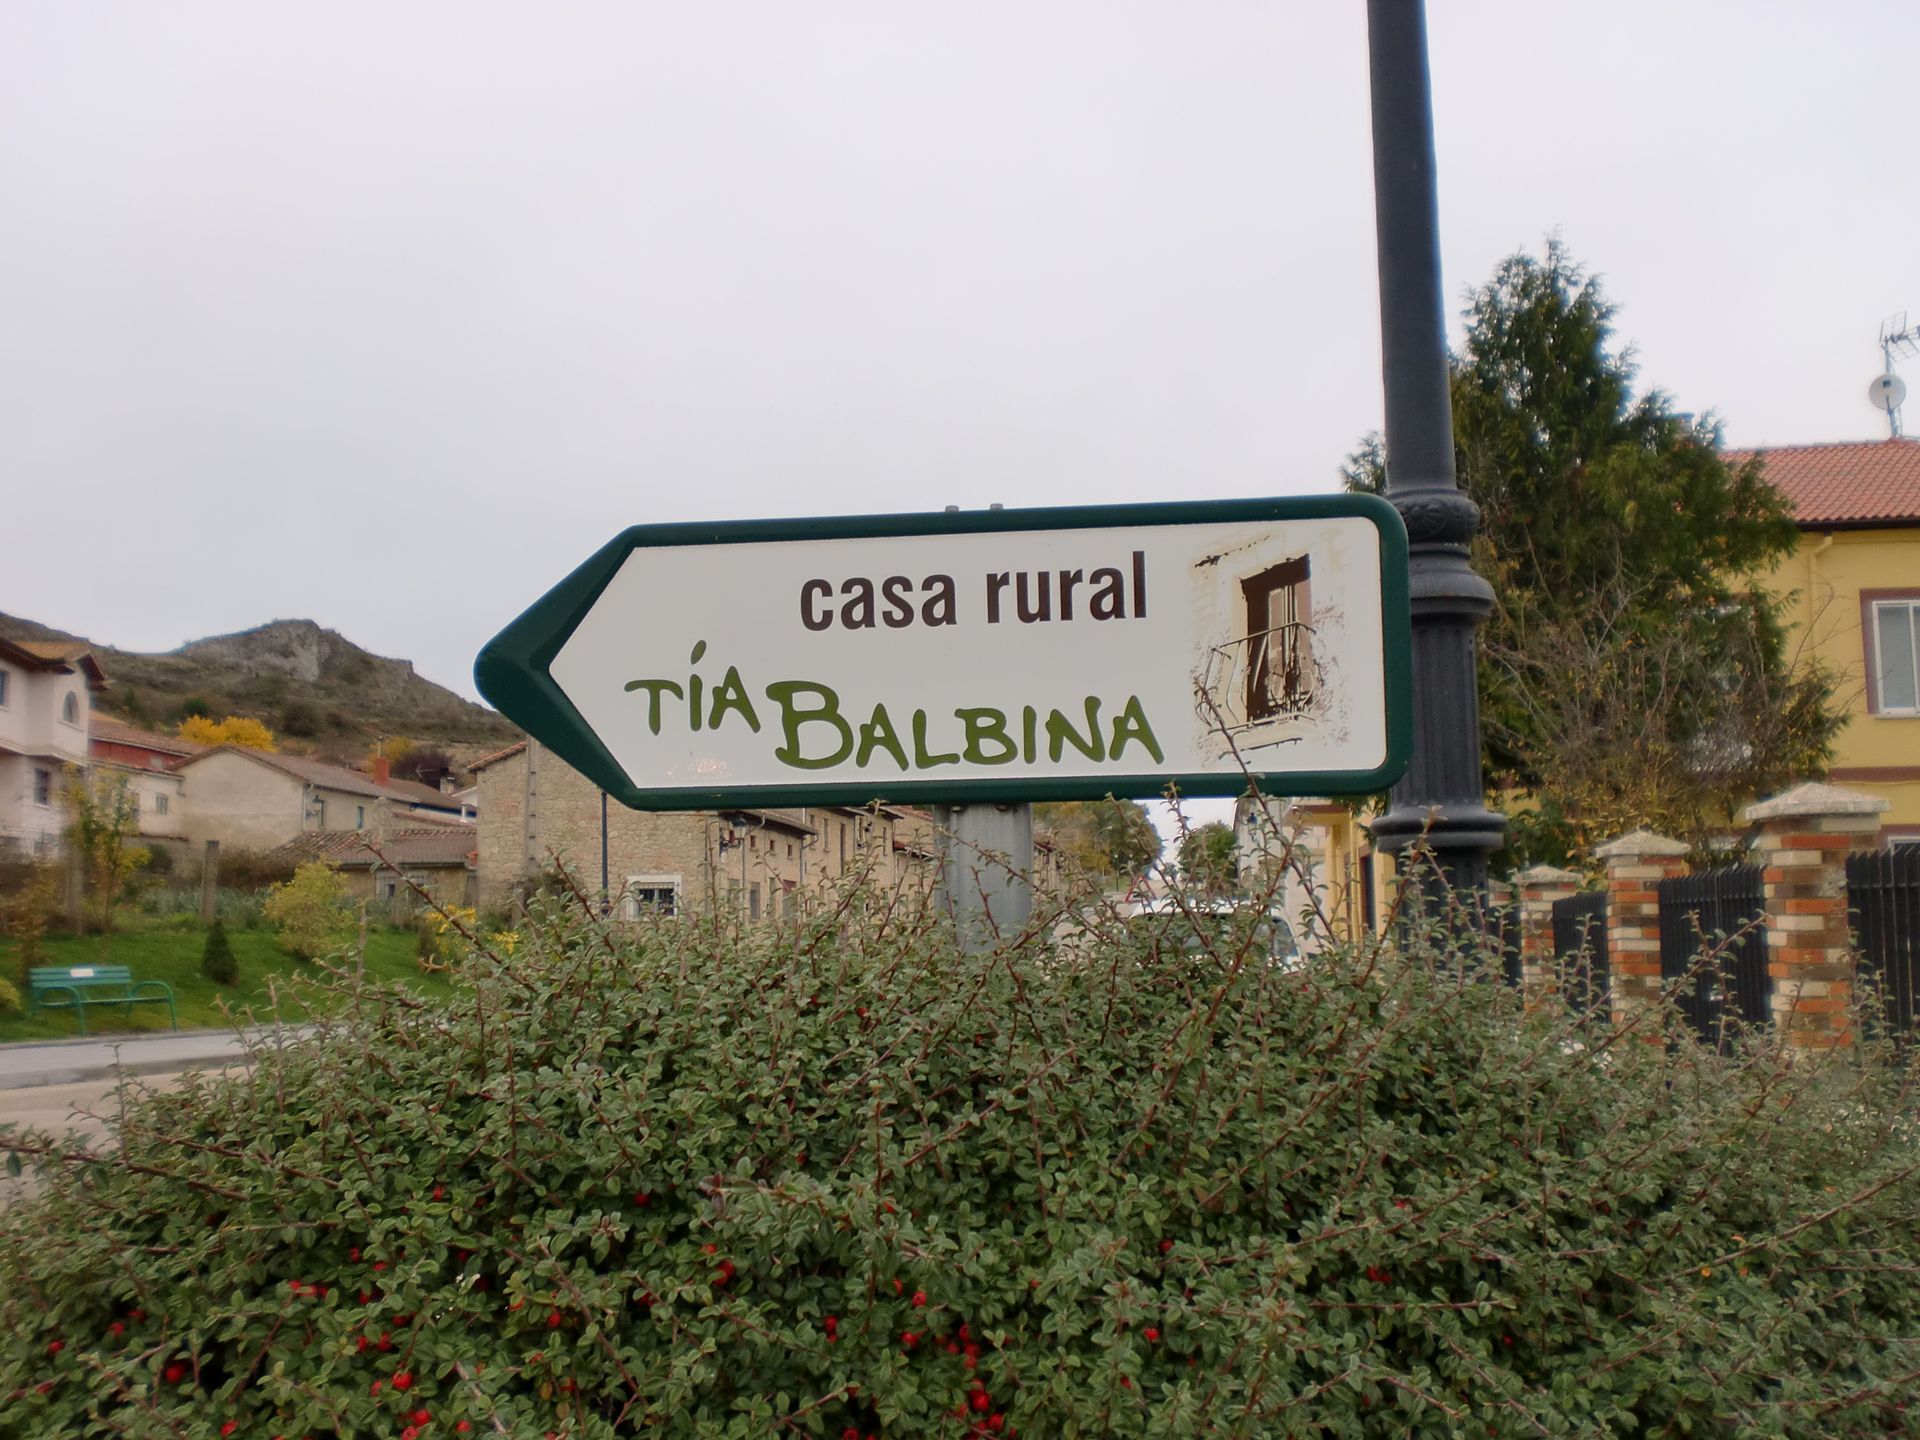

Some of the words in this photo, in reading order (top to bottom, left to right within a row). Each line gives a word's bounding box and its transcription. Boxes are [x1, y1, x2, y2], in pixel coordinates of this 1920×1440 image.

[800, 574, 957, 632] casa
[986, 550, 1147, 624] rural
[765, 679, 1165, 772] BALBINA
